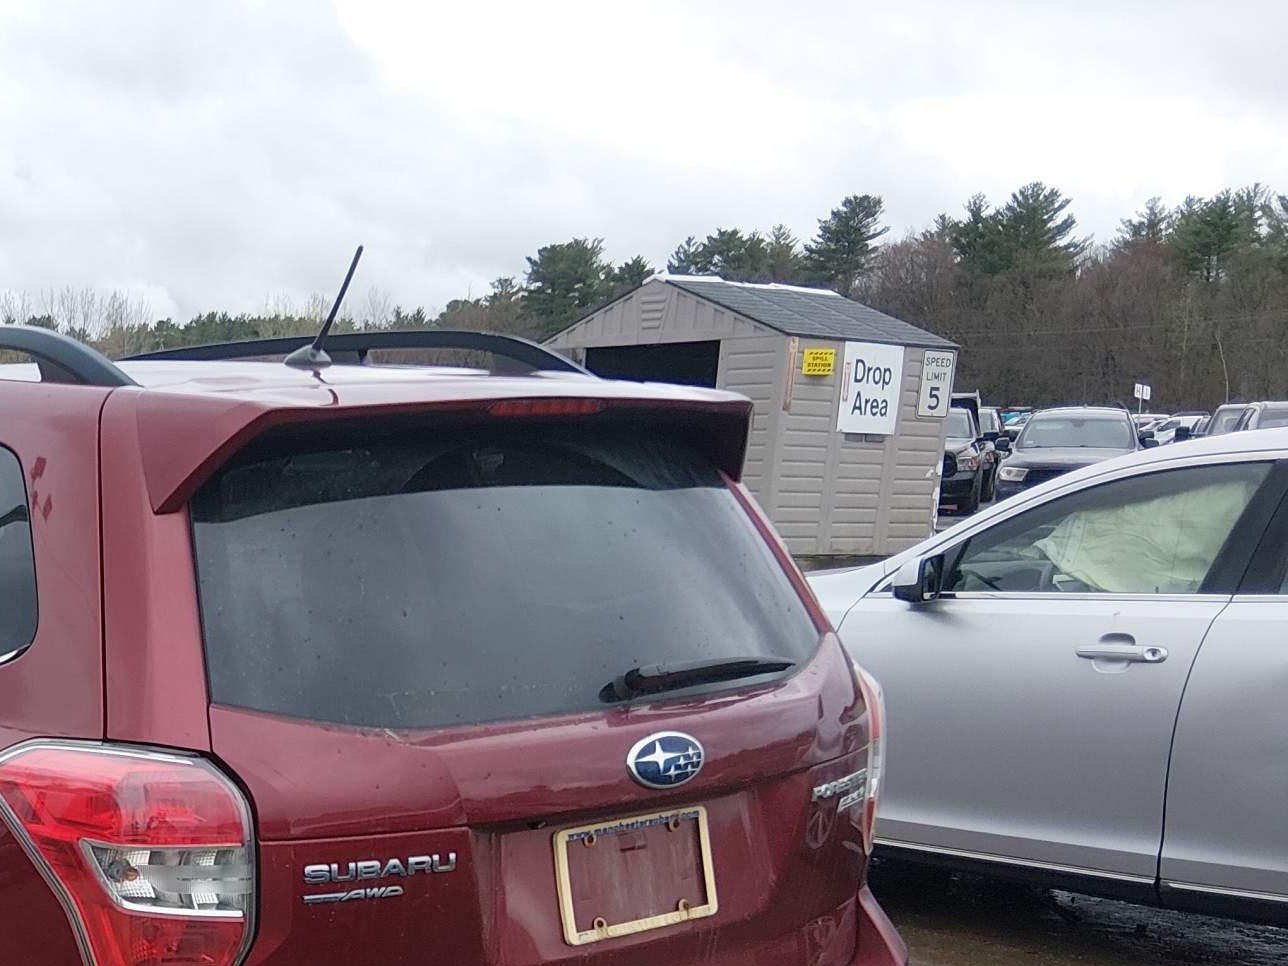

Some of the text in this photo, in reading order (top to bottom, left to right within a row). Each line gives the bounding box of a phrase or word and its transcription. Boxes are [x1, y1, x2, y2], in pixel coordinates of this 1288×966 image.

[853, 358, 893, 391] Drop
[925, 356, 952, 368] SPEED
[926, 371, 947, 382] LIMIT
[851, 390, 889, 417] Area
[927, 386, 940, 411] 5
[567, 809, 700, 841] www.manchestersuba.com
[303, 852, 457, 884] SUBARU
[340, 885, 405, 902] AWD
